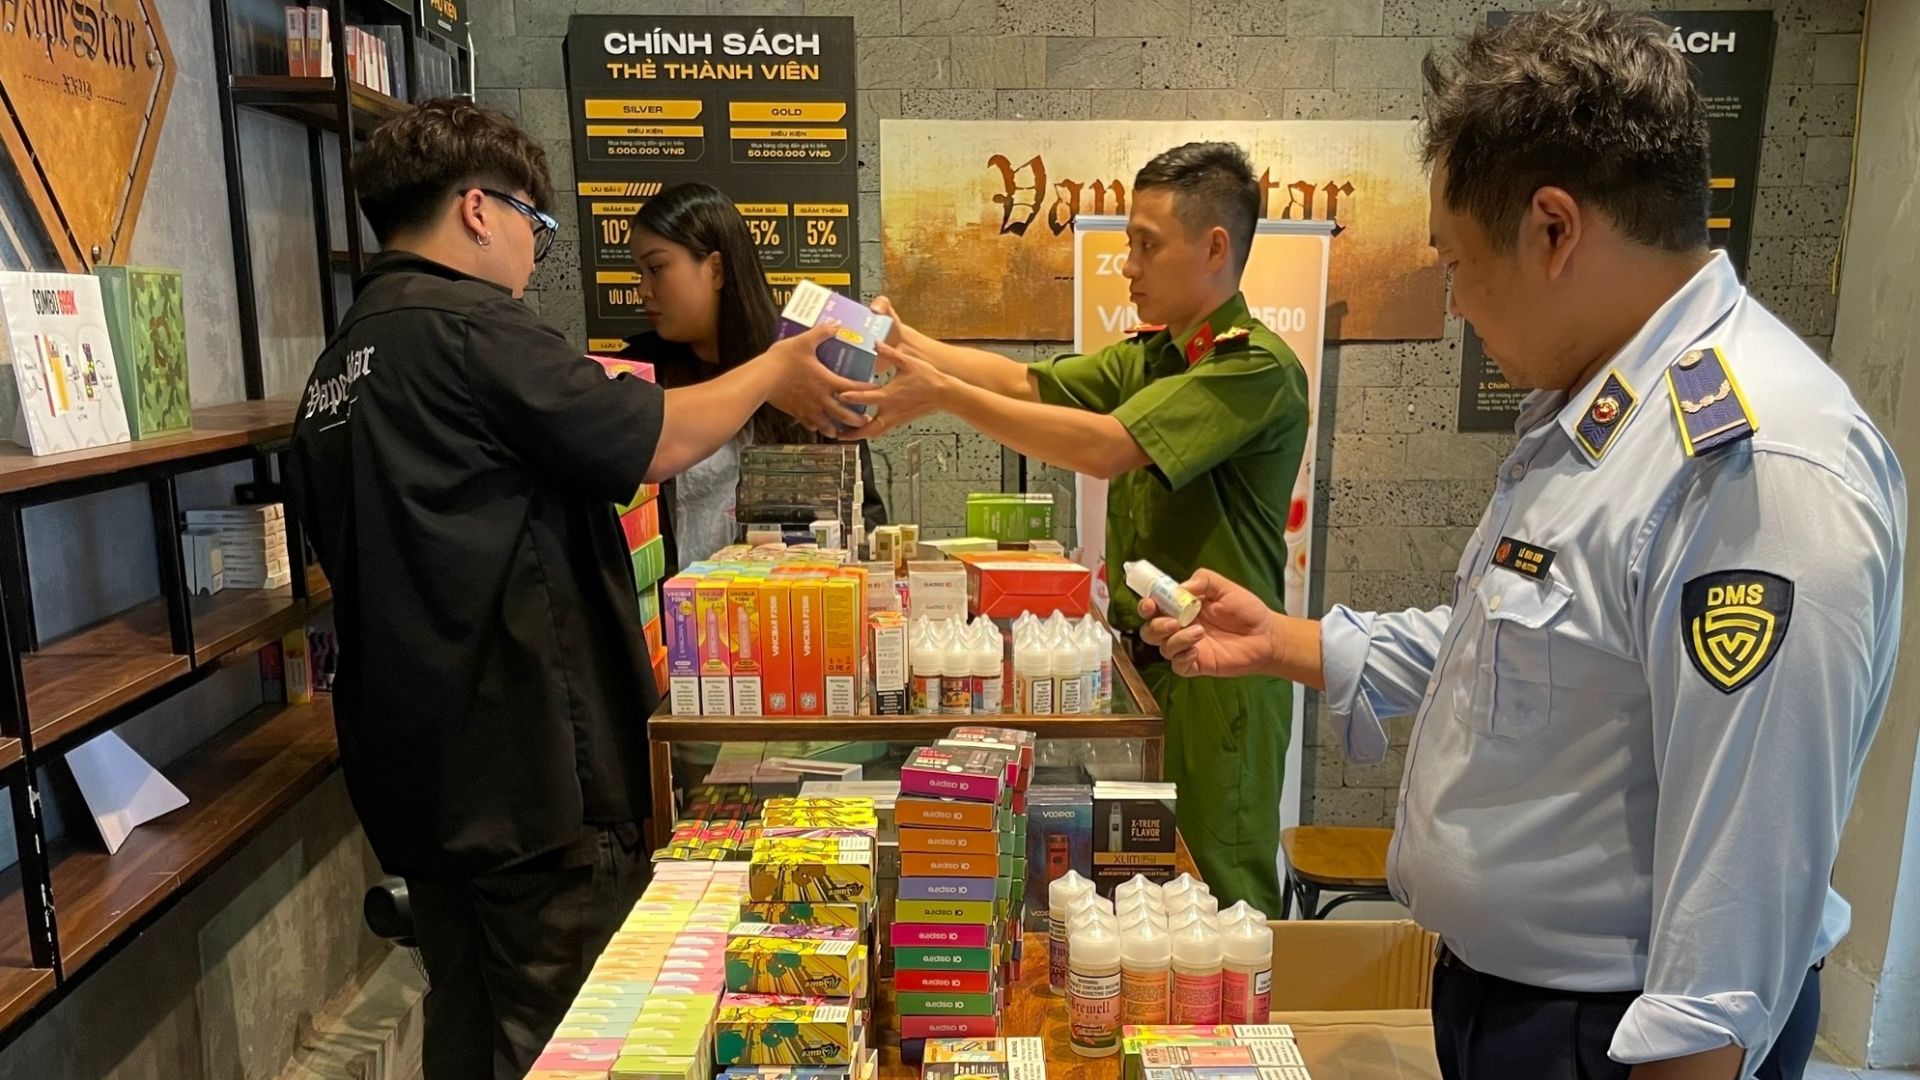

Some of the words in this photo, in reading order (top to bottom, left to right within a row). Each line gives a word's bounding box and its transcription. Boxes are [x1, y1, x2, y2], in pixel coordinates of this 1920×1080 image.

[604, 28, 712, 56] CHÍNH
[722, 28, 820, 56] SÁCH
[607, 58, 657, 80] THẺ
[664, 60, 753, 80] THÀNH
[761, 60, 819, 81] VIÊN
[623, 105, 663, 114] SILVER
[771, 107, 803, 116] GOLD
[607, 147, 660, 155] 5.000.000
[662, 147, 685, 155] VND
[748, 149, 806, 158] 50.000.000
[808, 150, 831, 158] VND
[745, 220, 780, 246] 5%
[807, 220, 837, 246] 5%
[32, 289, 60, 316] COMBO
[1707, 583, 1766, 607] DMS
[1131, 819, 1160, 828] X-TREME
[1131, 828, 1160, 837] FLAVOR
